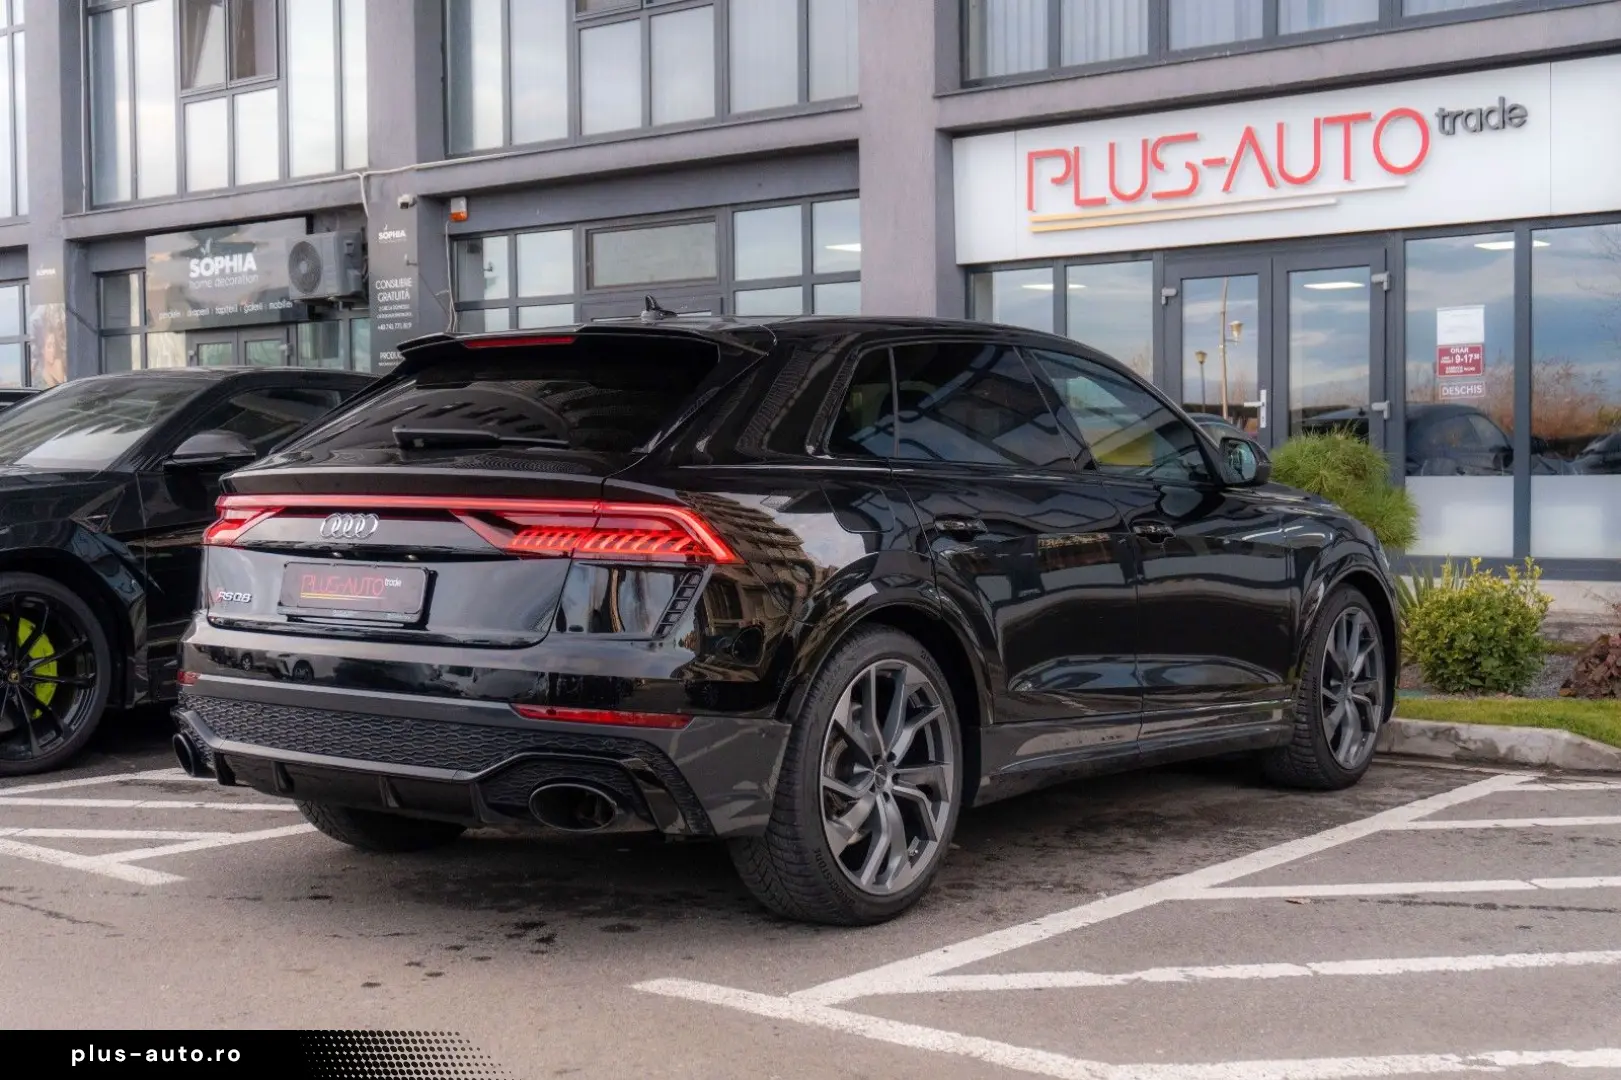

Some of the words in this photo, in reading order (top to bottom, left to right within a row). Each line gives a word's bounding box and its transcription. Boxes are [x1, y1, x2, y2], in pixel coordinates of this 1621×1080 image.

[1027, 107, 1431, 212] PLUS-AUTO
[1435, 97, 1529, 136] trade
[379, 229, 407, 240] SOPHIA
[189, 252, 258, 278] SOPHIA
[215, 273, 259, 288] decoration
[1441, 385, 1483, 396] DESCHIS
[300, 573, 384, 596] PLUS-AUTO
[384, 577, 402, 588] trade
